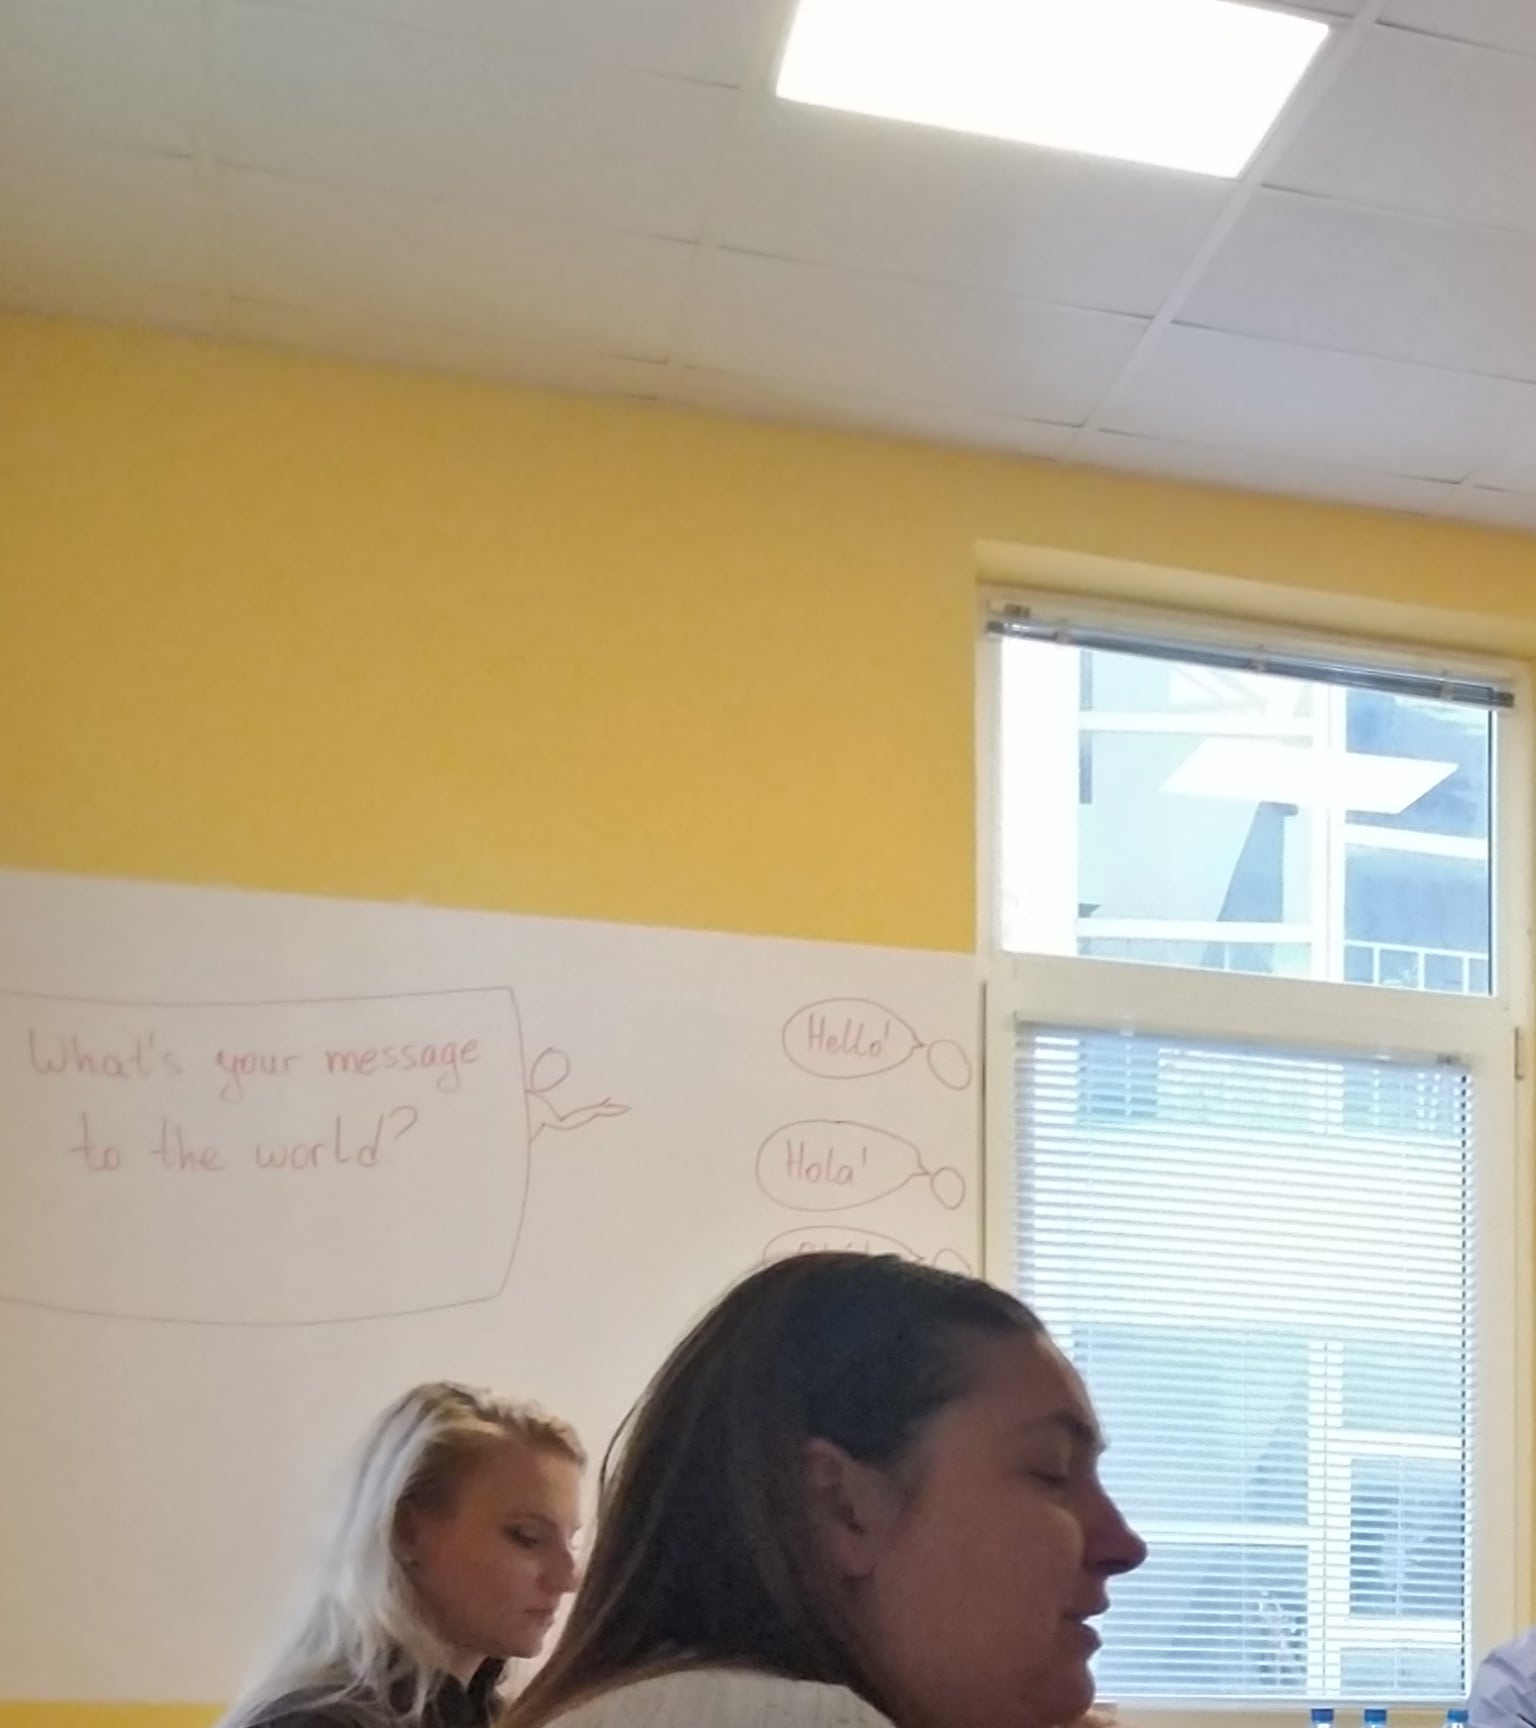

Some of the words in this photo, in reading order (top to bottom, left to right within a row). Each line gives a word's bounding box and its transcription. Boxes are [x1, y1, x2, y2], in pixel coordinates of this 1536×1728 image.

[27, 1028, 183, 1078] What's
[215, 1047, 304, 1103] your
[325, 1036, 483, 1092] message
[68, 1110, 123, 1172] to
[151, 1115, 226, 1172] the
[254, 1105, 419, 1169] world?
